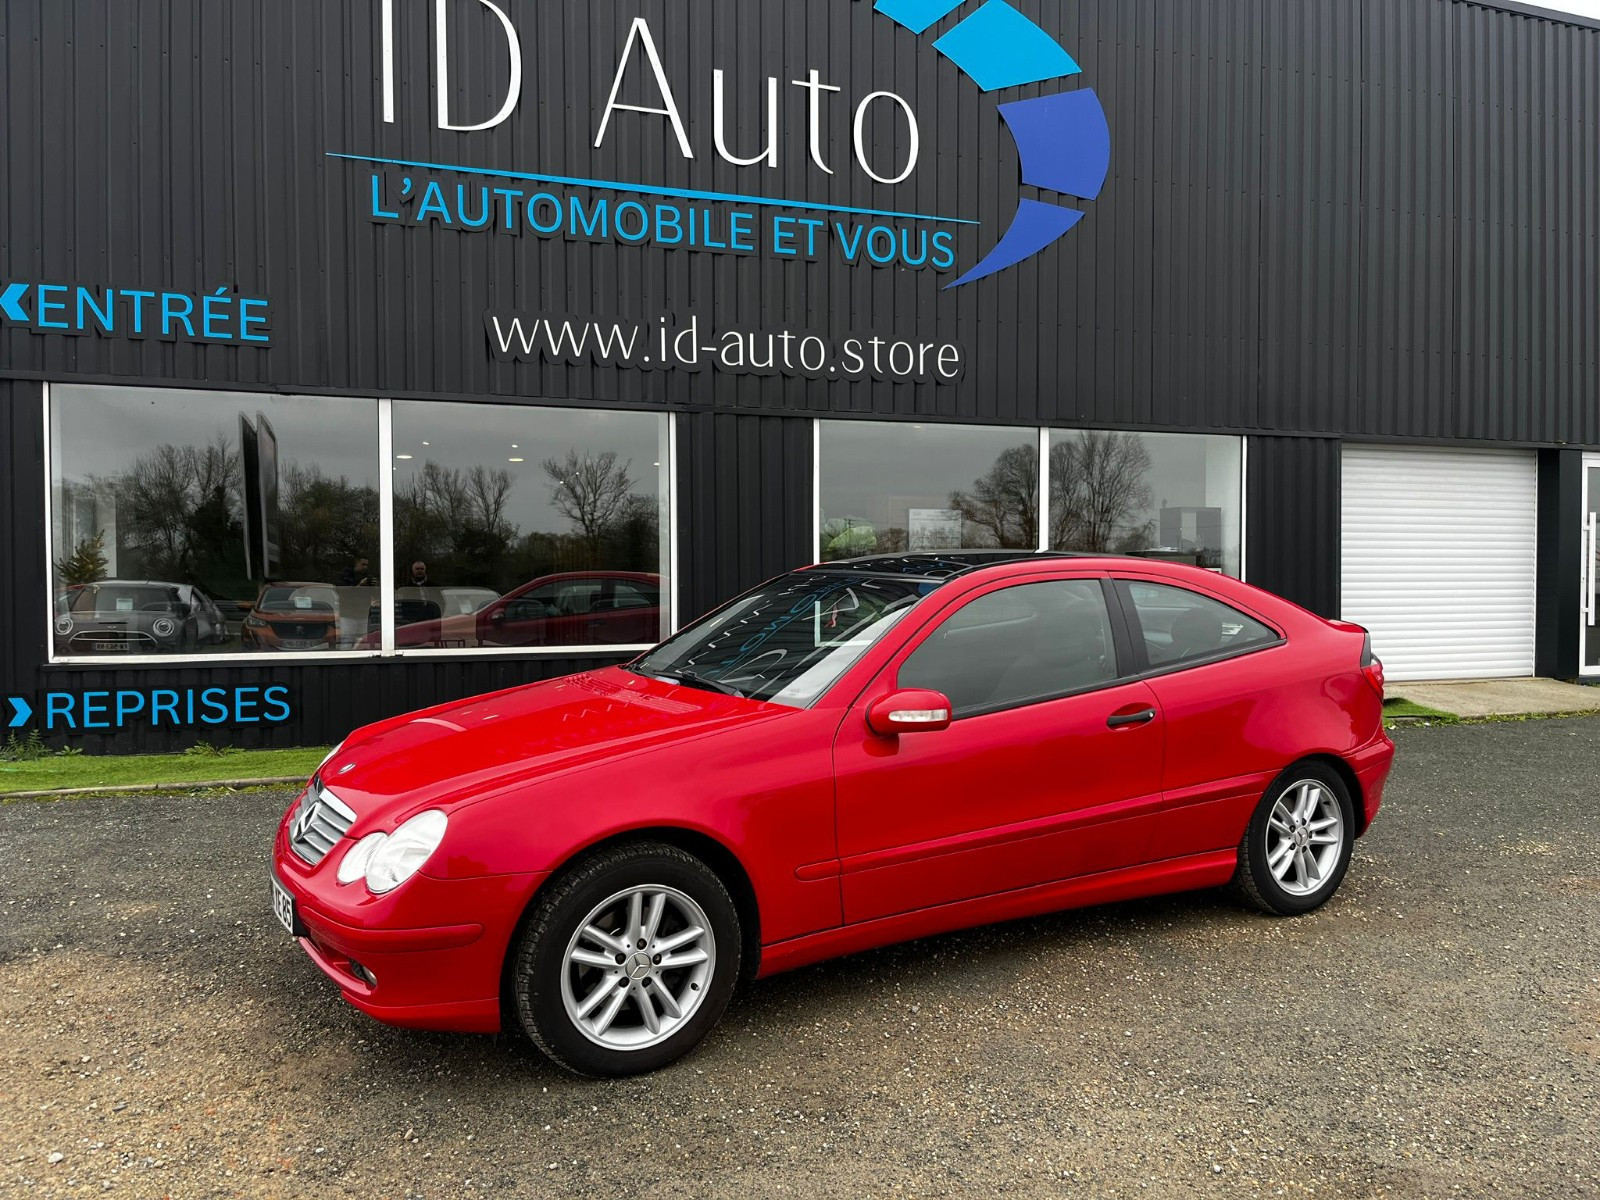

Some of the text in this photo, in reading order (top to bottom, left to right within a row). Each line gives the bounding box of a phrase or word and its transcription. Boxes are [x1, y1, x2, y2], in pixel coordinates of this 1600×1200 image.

[381, 0, 919, 184] ID Auto
[773, 216, 824, 256] ET
[835, 223, 954, 269] VOUS
[37, 284, 269, 342] ENTRÉE
[492, 315, 961, 379] www.id-auto.store
[46, 686, 291, 729] REPRISES
